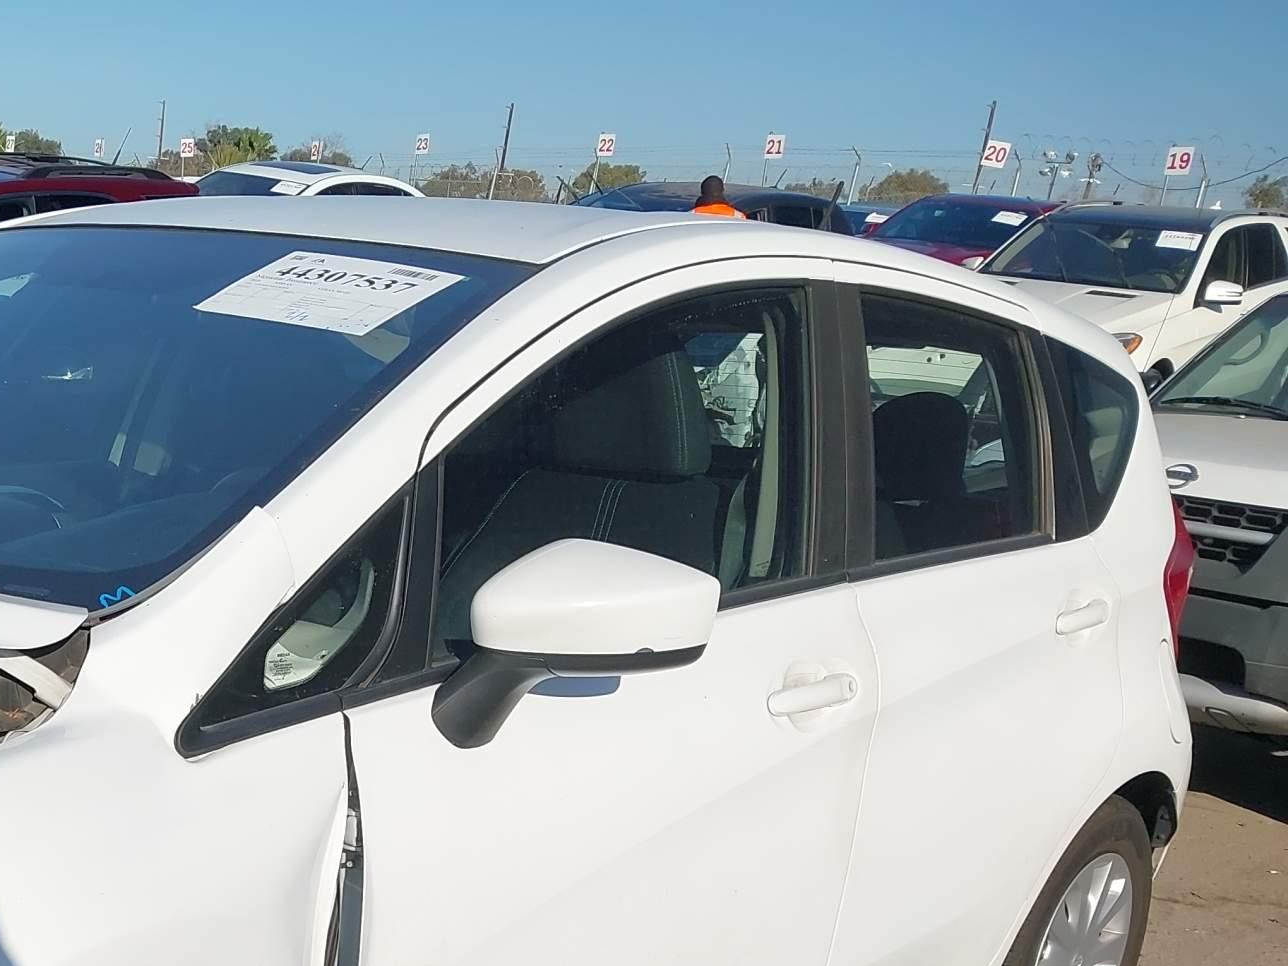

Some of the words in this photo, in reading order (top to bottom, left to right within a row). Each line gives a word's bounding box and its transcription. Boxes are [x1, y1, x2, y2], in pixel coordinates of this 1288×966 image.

[6, 138, 15, 150] 27
[181, 142, 194, 154] 25
[416, 137, 429, 151] 23
[598, 138, 615, 153] 22
[765, 139, 783, 155] 21
[983, 145, 1008, 164] 20
[1166, 151, 1192, 170] 19
[275, 265, 419, 294] 44307537
